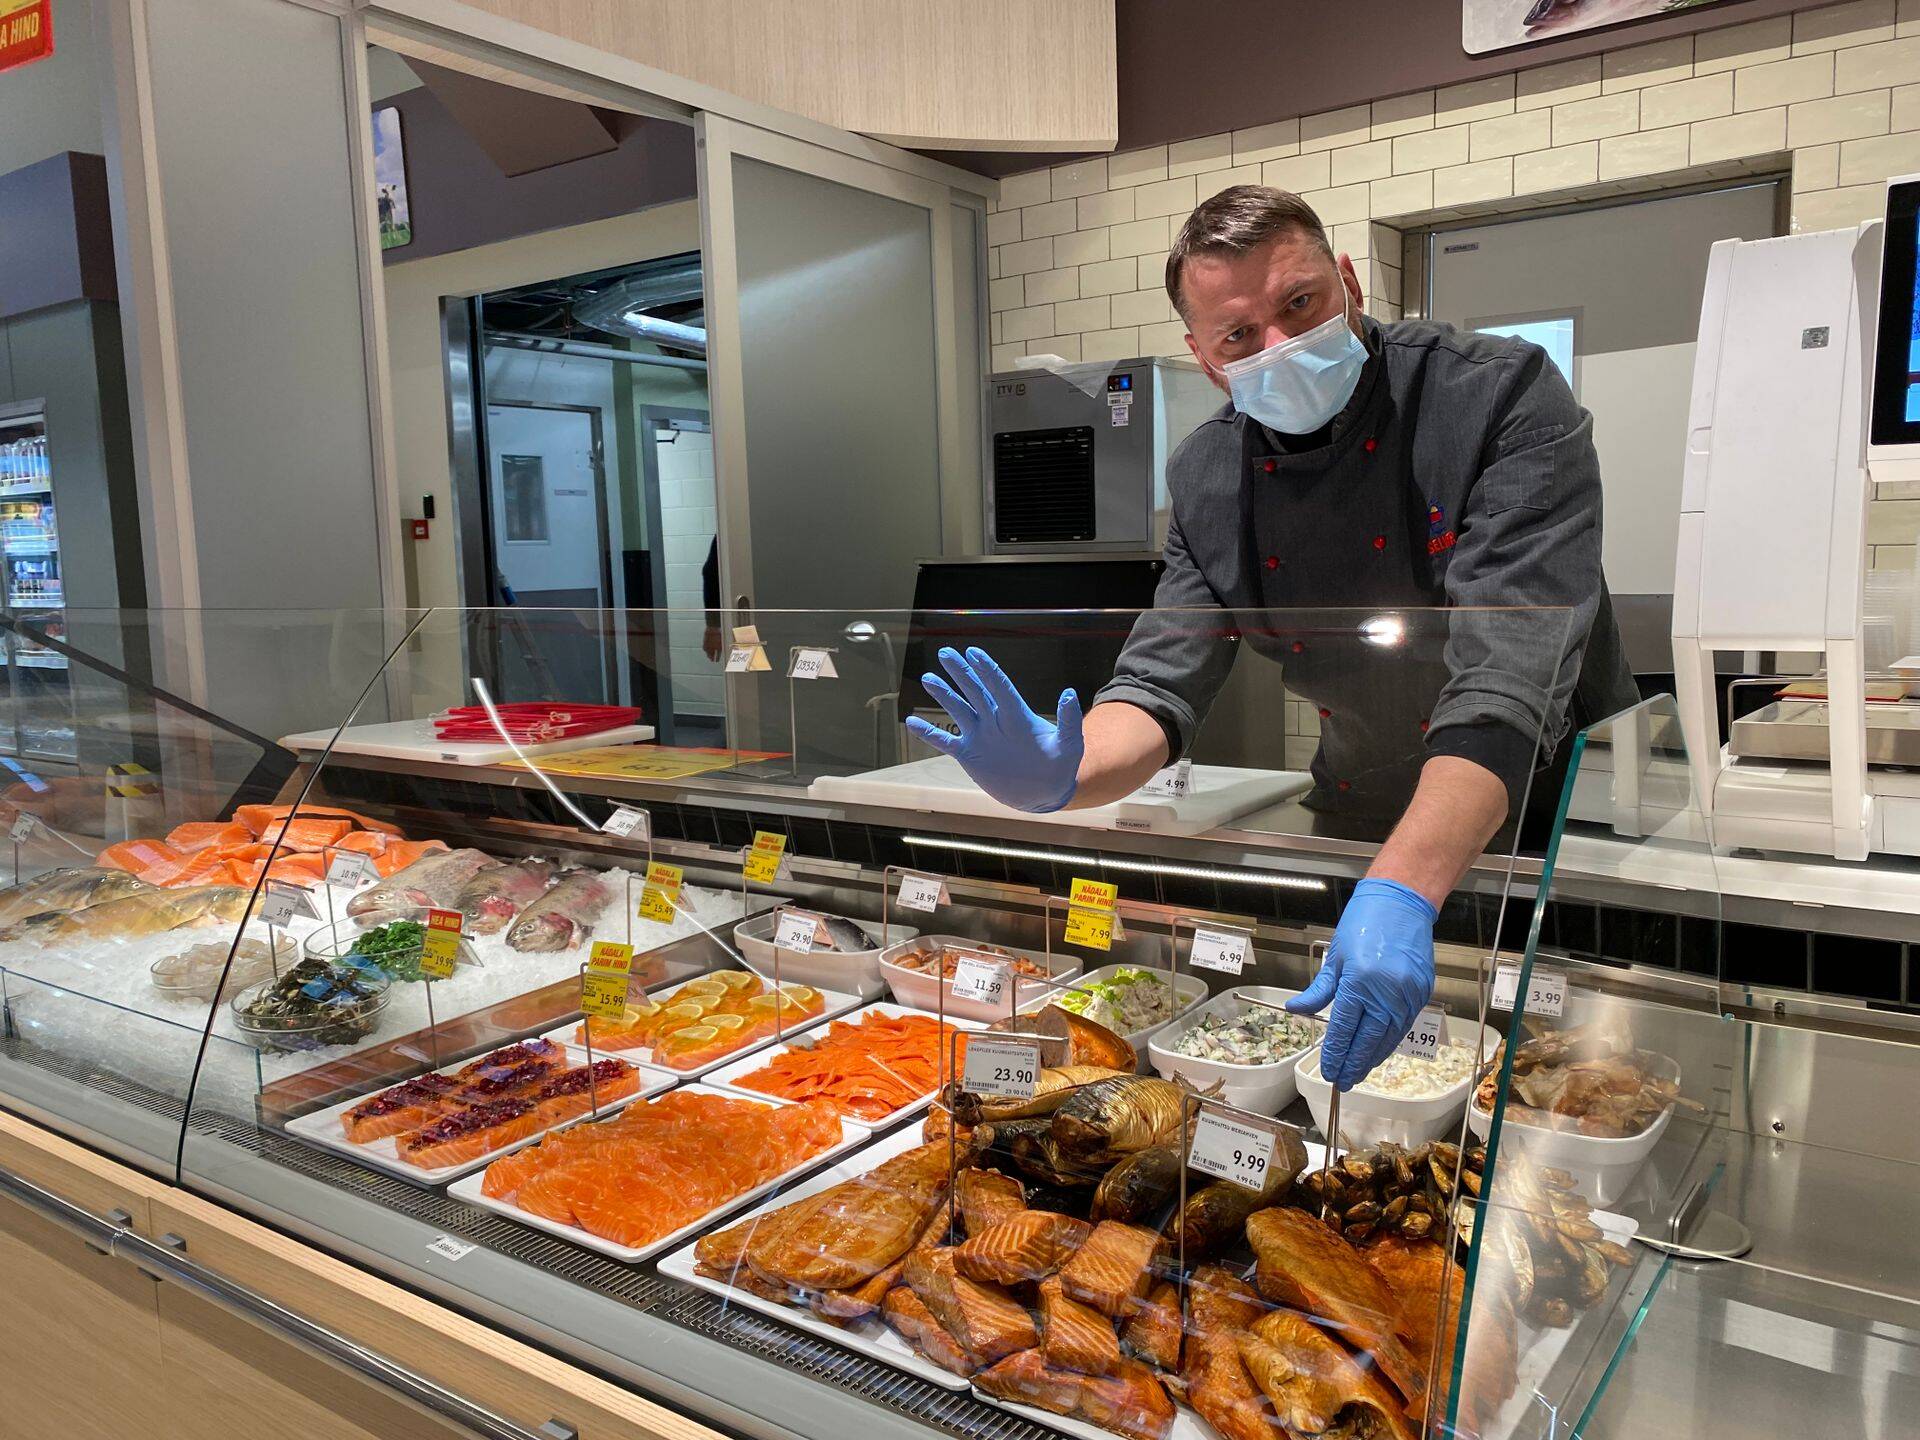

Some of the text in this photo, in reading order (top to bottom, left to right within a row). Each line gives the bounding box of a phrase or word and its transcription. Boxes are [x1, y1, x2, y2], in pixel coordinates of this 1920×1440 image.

[10, 12, 39, 45] HIND
[996, 385, 1012, 395] ITV
[1165, 778, 1185, 789] 4.99
[915, 891, 936, 904] 18.99
[1081, 885, 1107, 897] NÄDALA
[1074, 893, 1114, 908] PARIM HIND
[791, 931, 812, 945] 29.90
[1091, 927, 1111, 940] 7.99
[591, 957, 629, 970] PARIM HIND
[1219, 950, 1242, 964] 6.99
[974, 978, 1002, 994] 11.59
[599, 993, 624, 1007] 15.99
[1532, 990, 1561, 1005] 3.99
[1406, 1030, 1436, 1047] 4.99
[994, 1067, 1033, 1084] 23.90
[1233, 1149, 1266, 1173] 9.99
